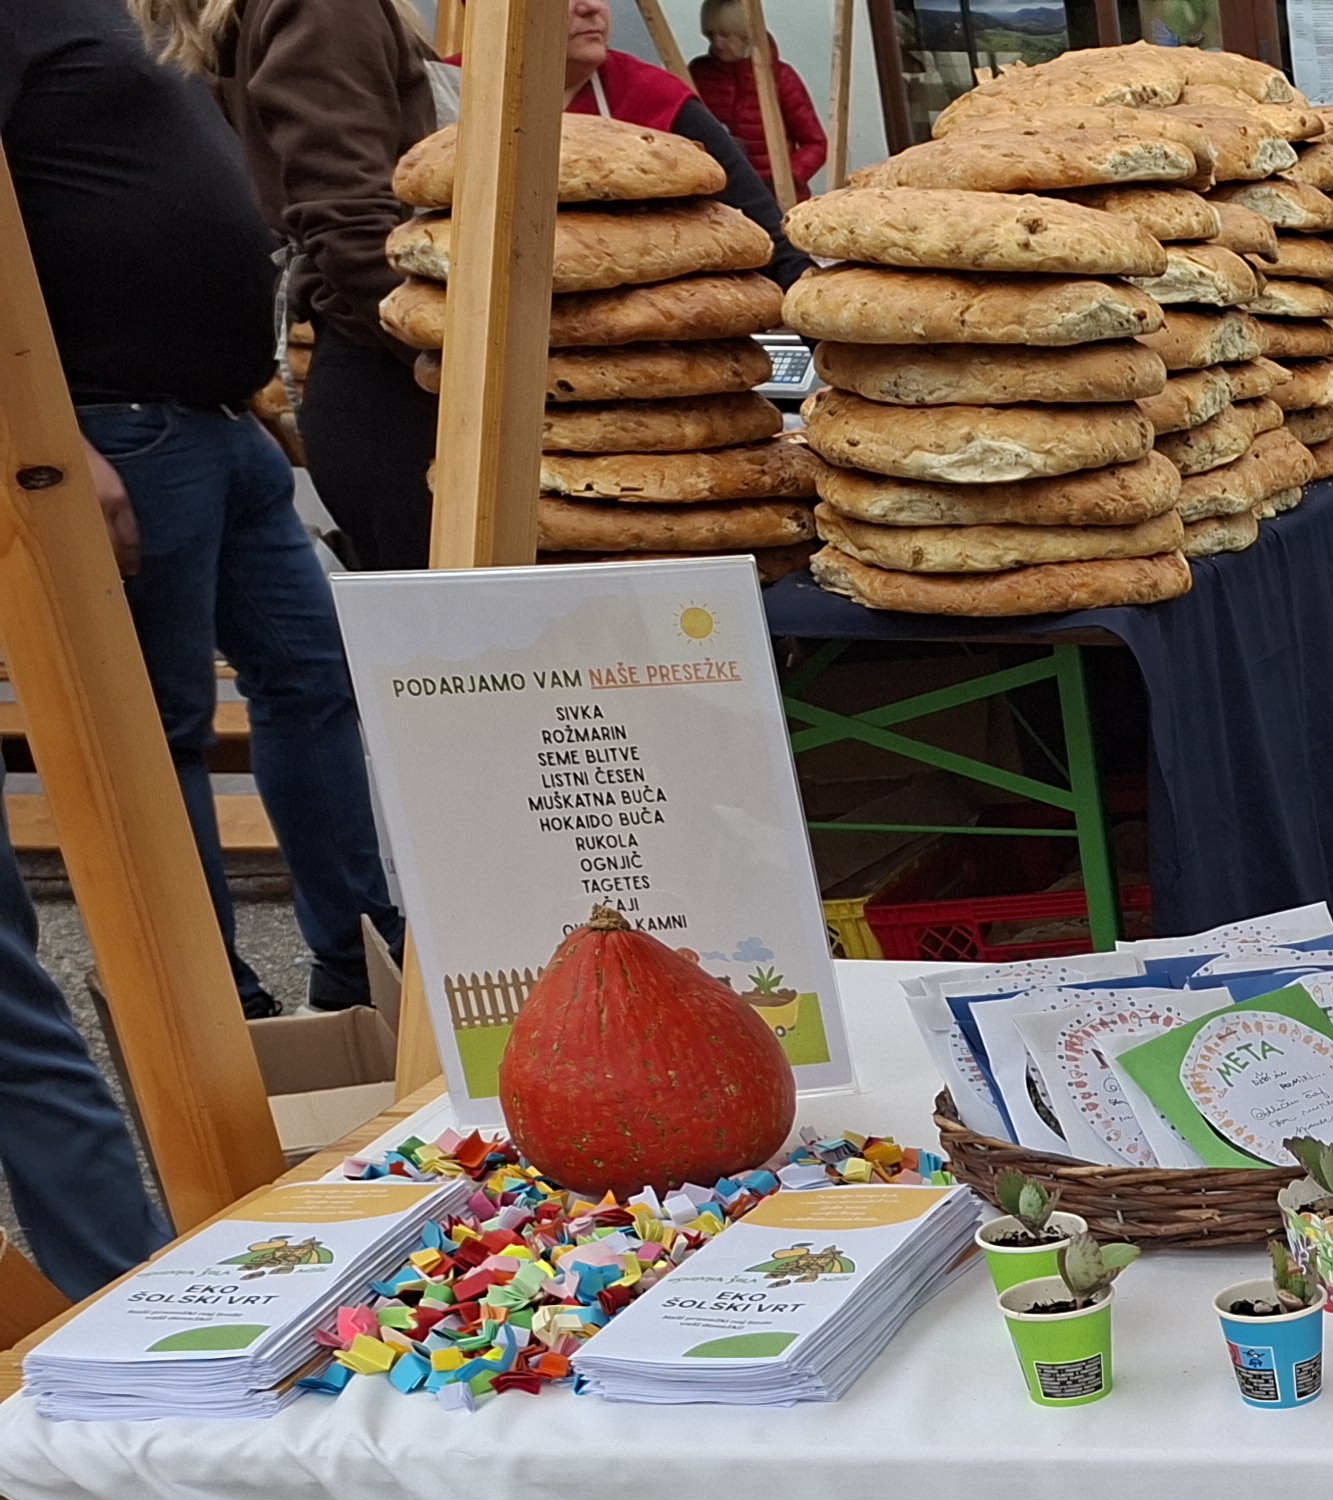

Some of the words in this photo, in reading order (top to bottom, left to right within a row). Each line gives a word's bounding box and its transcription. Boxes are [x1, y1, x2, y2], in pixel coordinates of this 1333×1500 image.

[392, 673, 525, 697] PODARJAMO
[533, 669, 582, 690] VAM
[589, 662, 638, 687] NAŠE
[647, 658, 741, 683] PRESEŽKE
[556, 705, 603, 721] SIVKA
[542, 725, 626, 745] ROŽMARIN
[538, 750, 580, 766] SEME
[586, 746, 640, 764] BLITVE
[542, 771, 589, 788] LISTNI
[595, 767, 644, 785] ČESEN
[528, 791, 616, 811] MUŠKATNA
[620, 788, 667, 805] BUČA
[540, 814, 613, 832] HOKAIDO
[620, 809, 664, 828] BUČA
[575, 833, 638, 851] RUKOLA
[580, 851, 642, 873] OGNJIČ
[582, 875, 650, 894] TAGETES
[635, 915, 687, 931] KAMNI
[1216, 1040, 1284, 1087] META
[127, 1291, 222, 1305] ŠOLSKI
[227, 1295, 280, 1305] VRT
[185, 1284, 239, 1294] EKO
[716, 1291, 767, 1301] EKO
[662, 1297, 752, 1312] ŠOLSKI
[756, 1303, 807, 1313] VRT
